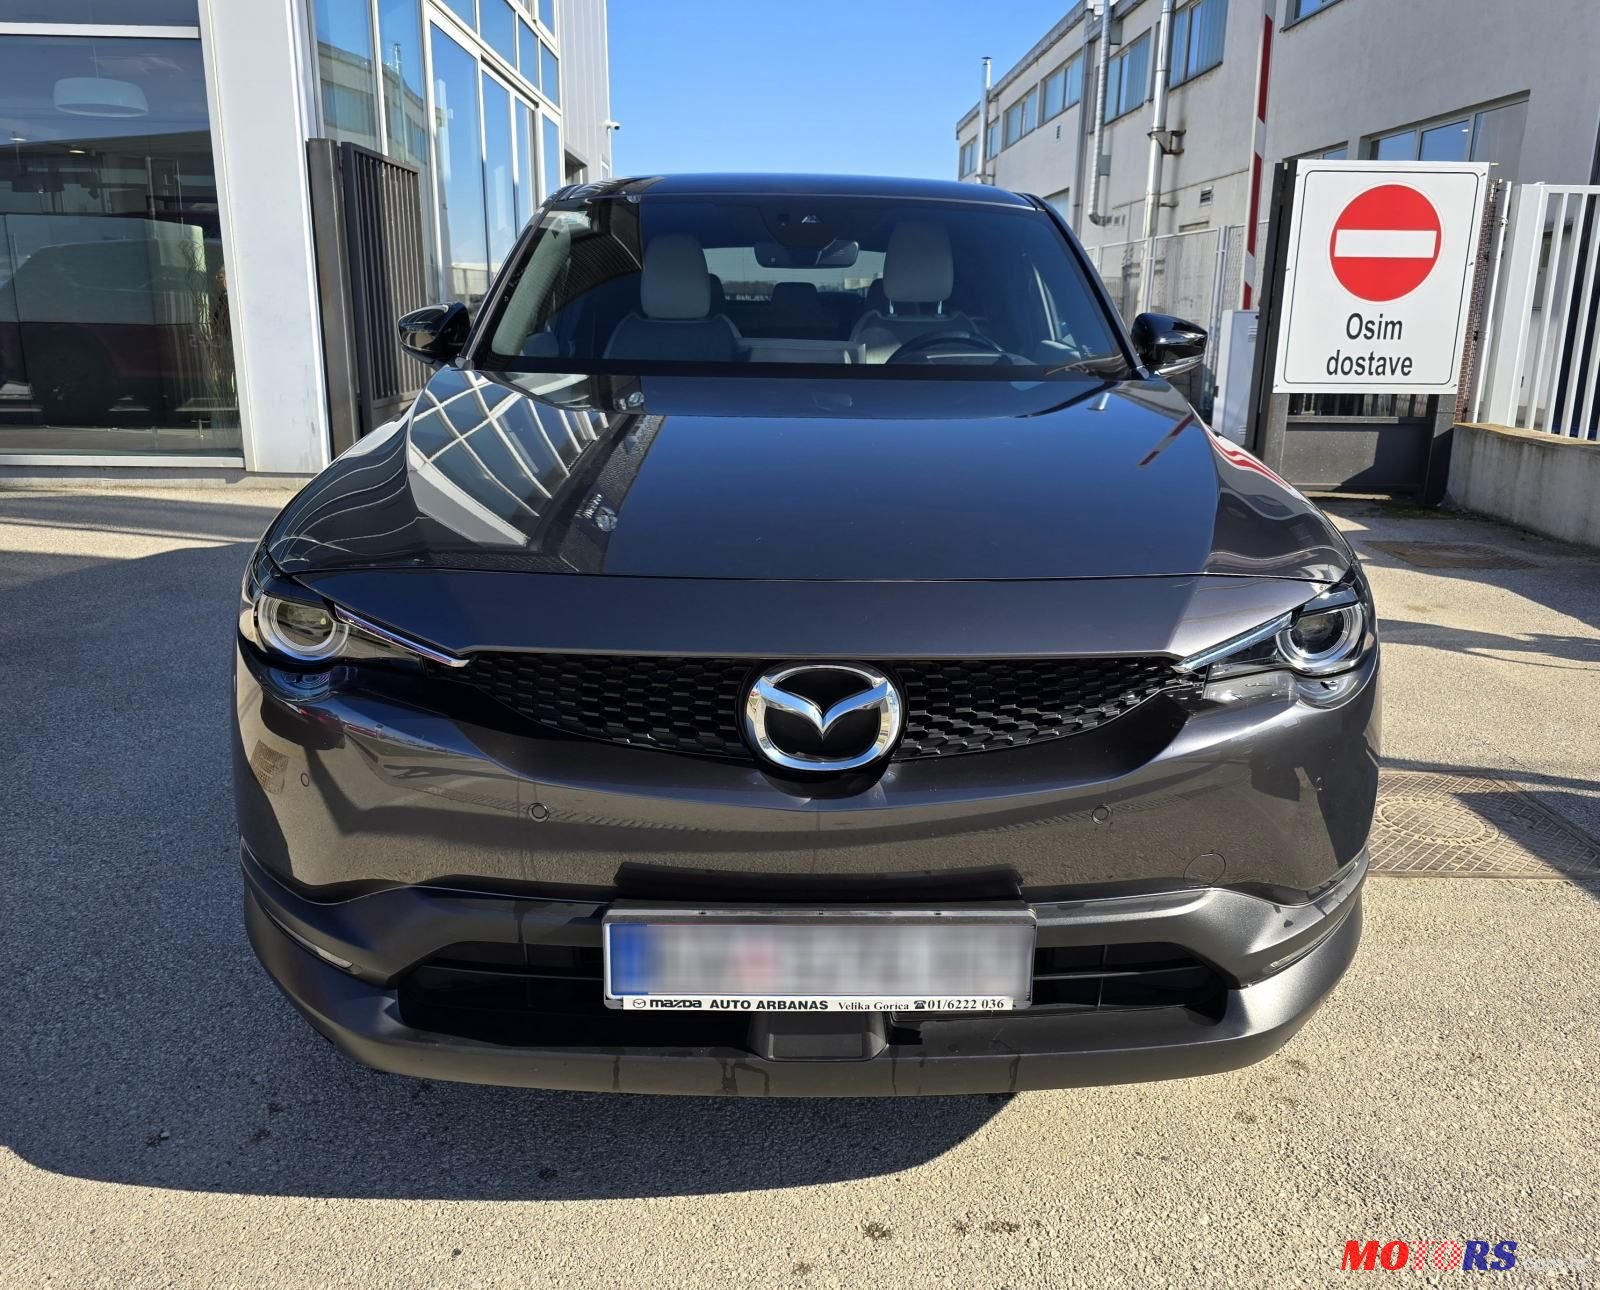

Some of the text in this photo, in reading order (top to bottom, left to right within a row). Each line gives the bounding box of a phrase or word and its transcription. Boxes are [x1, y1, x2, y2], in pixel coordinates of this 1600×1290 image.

[1346, 313, 1403, 340] Osim
[1326, 350, 1413, 377] dostave
[650, 999, 1004, 1010] mazda AUTO ARBANAS Velika Gorica 01/6222 036
